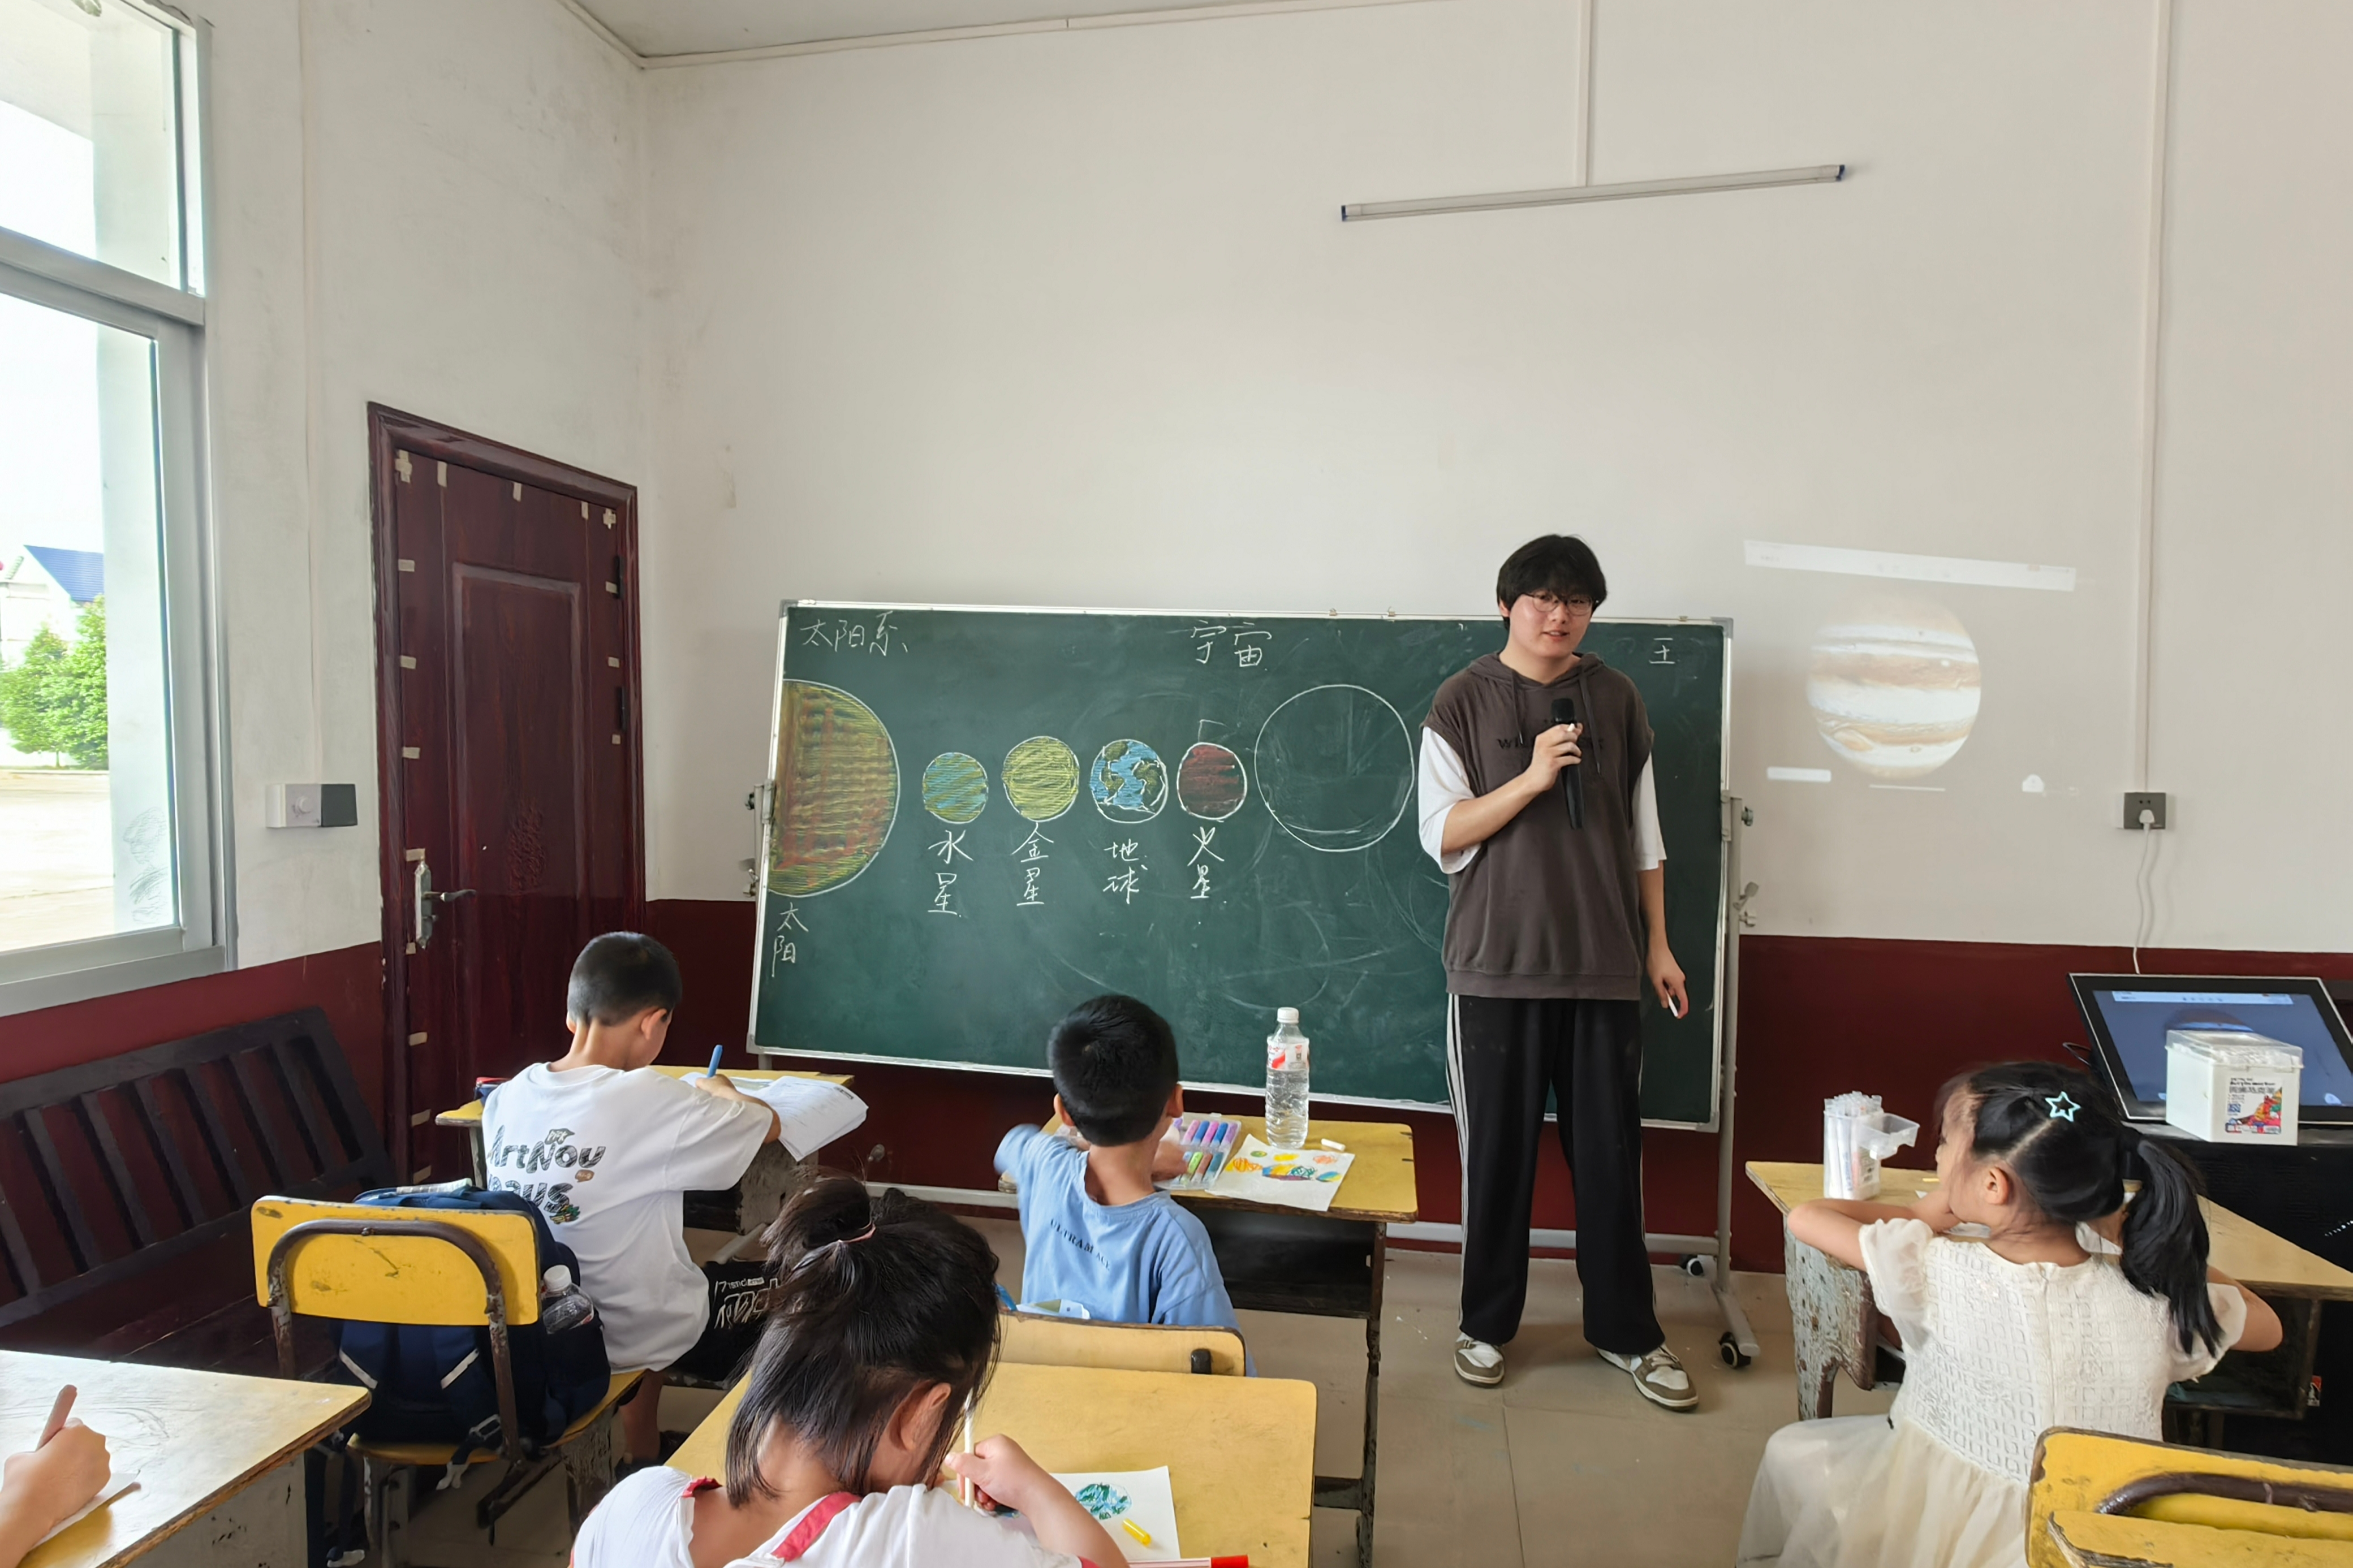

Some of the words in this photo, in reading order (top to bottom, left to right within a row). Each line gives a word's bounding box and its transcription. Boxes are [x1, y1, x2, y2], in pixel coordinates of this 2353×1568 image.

[799, 610, 908, 656] 太阳系
[1190, 619, 1273, 667] 宇宙
[927, 830, 974, 916] 水星
[1011, 822, 1054, 906] 金星
[1102, 839, 1148, 904] 地球
[1187, 826, 1225, 899] 火星
[772, 902, 809, 977] 太阳
